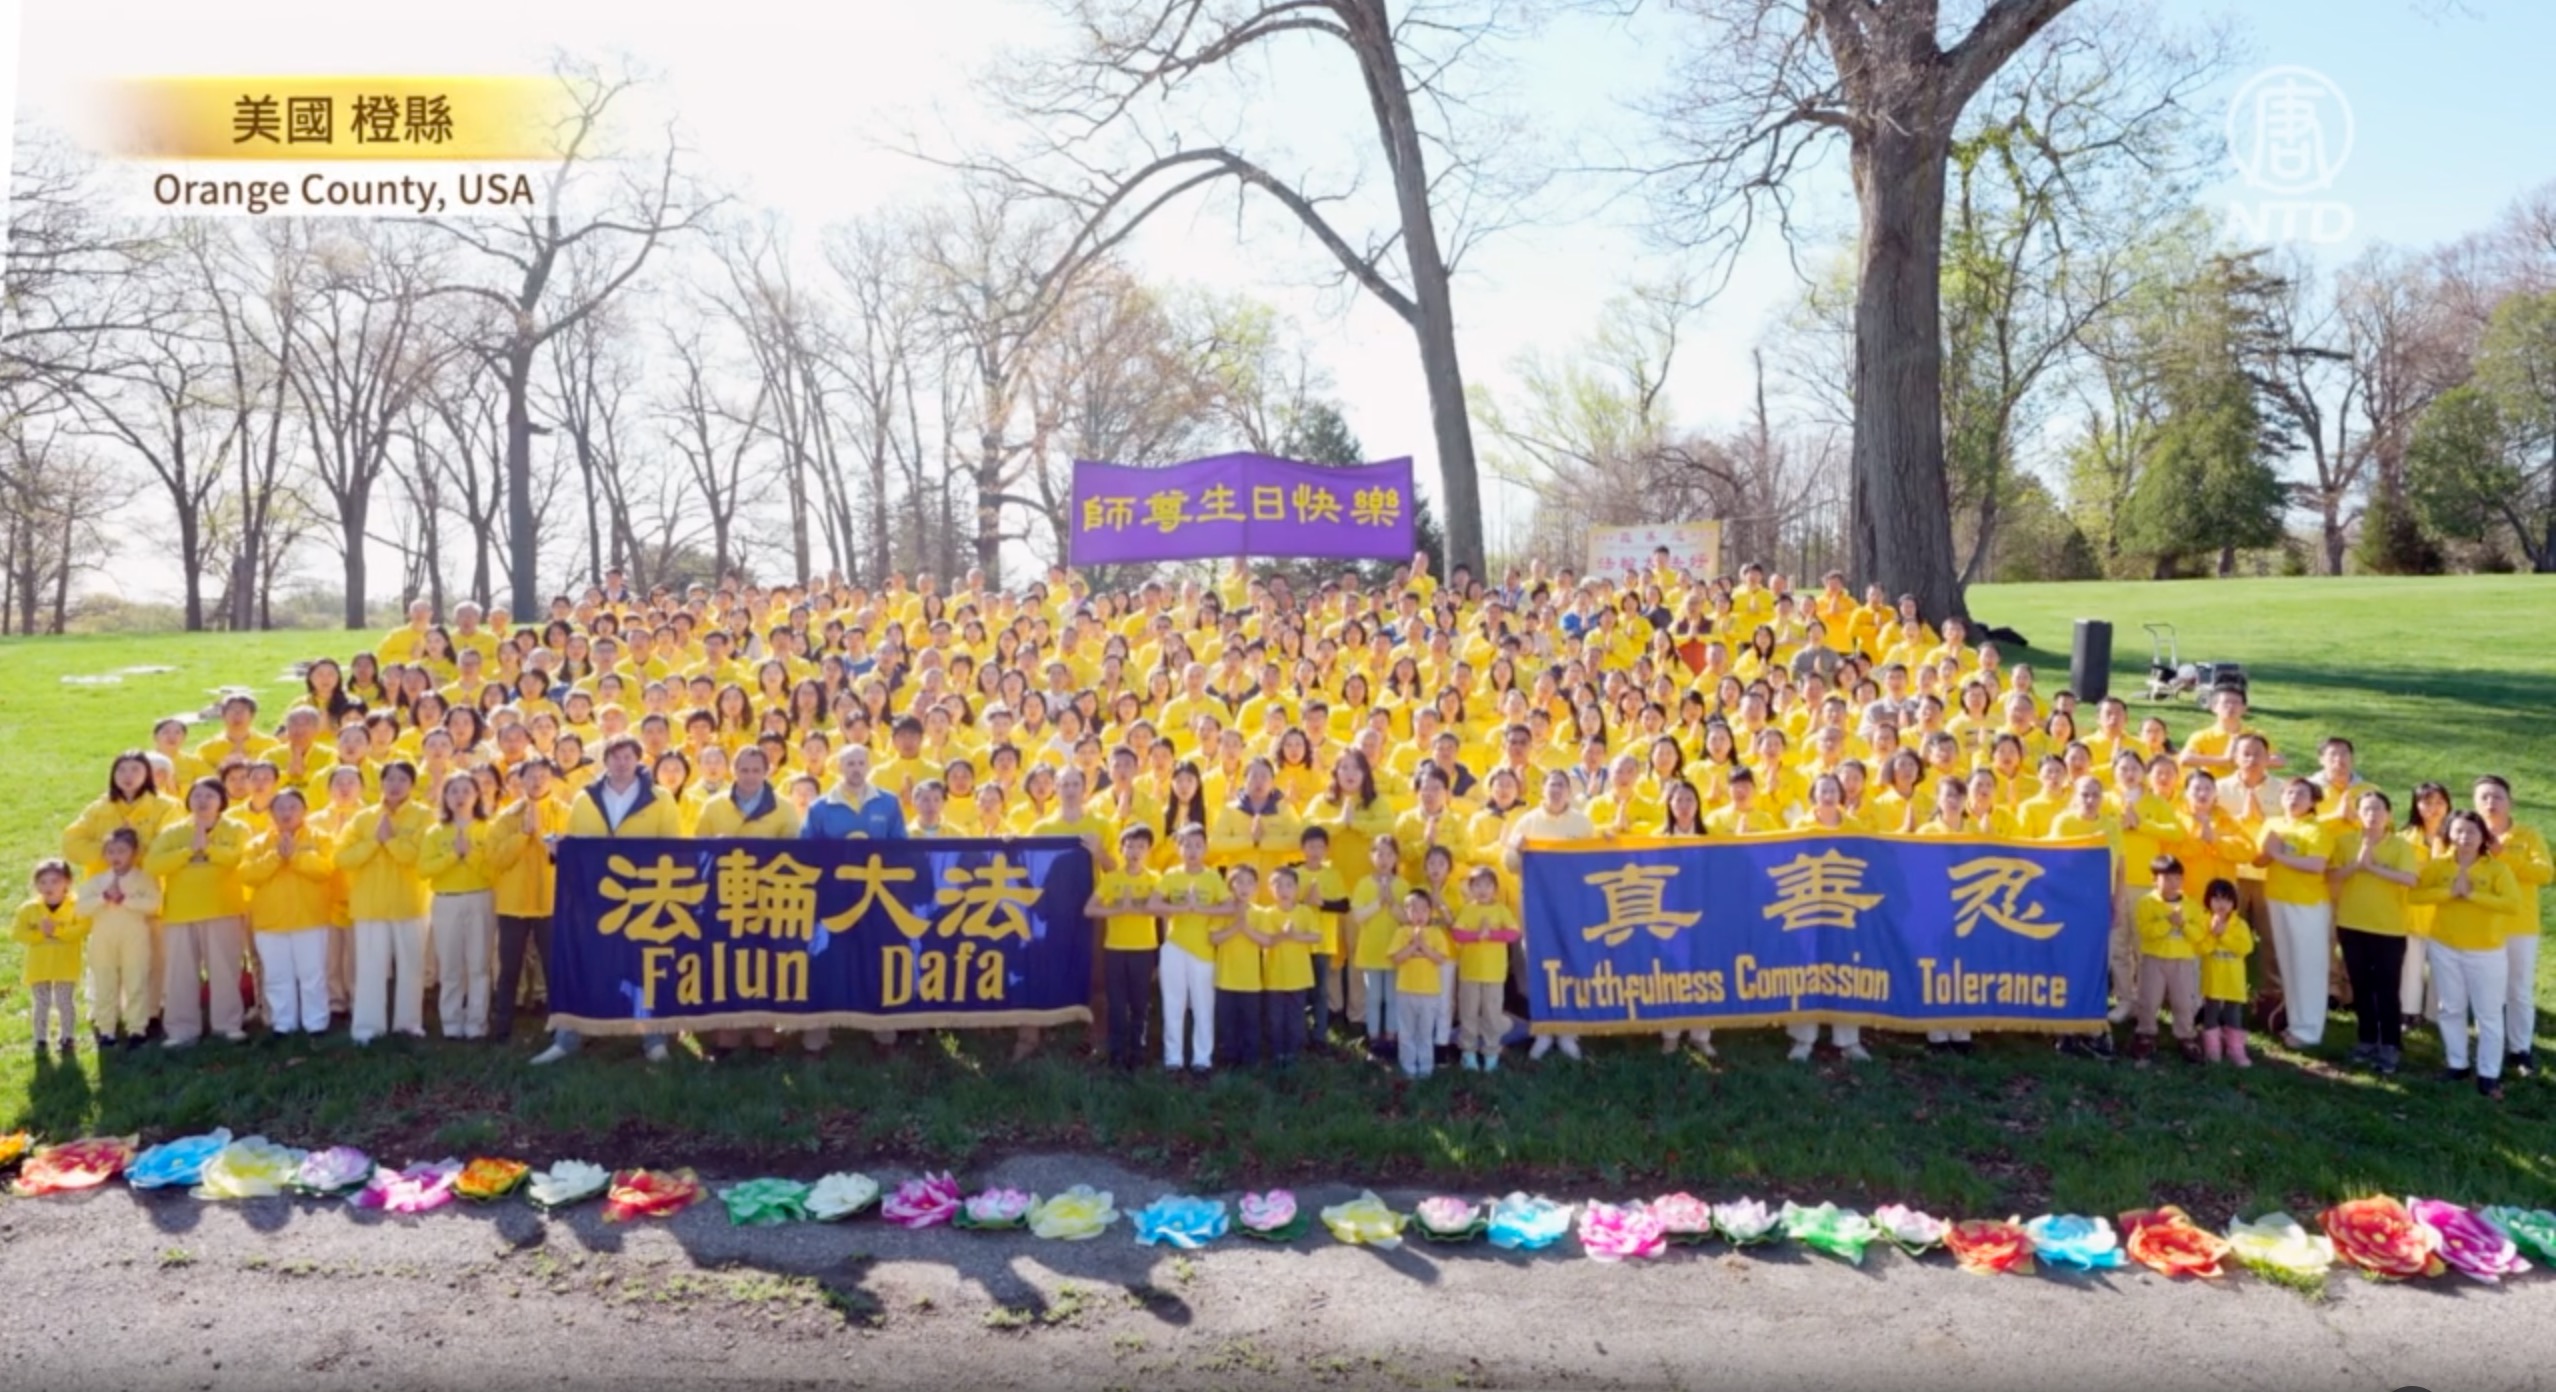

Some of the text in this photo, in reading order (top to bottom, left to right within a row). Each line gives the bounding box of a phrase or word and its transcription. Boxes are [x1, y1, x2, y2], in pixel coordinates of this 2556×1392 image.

[1082, 483, 1401, 534] 師尊生日快樂
[597, 847, 1043, 943] 法輪大法
[1582, 848, 2064, 945] 真 善 忍
[641, 942, 1005, 1010] Falun Dafa
[1542, 952, 2066, 1020] Truthfulness Compassion Tolerance
